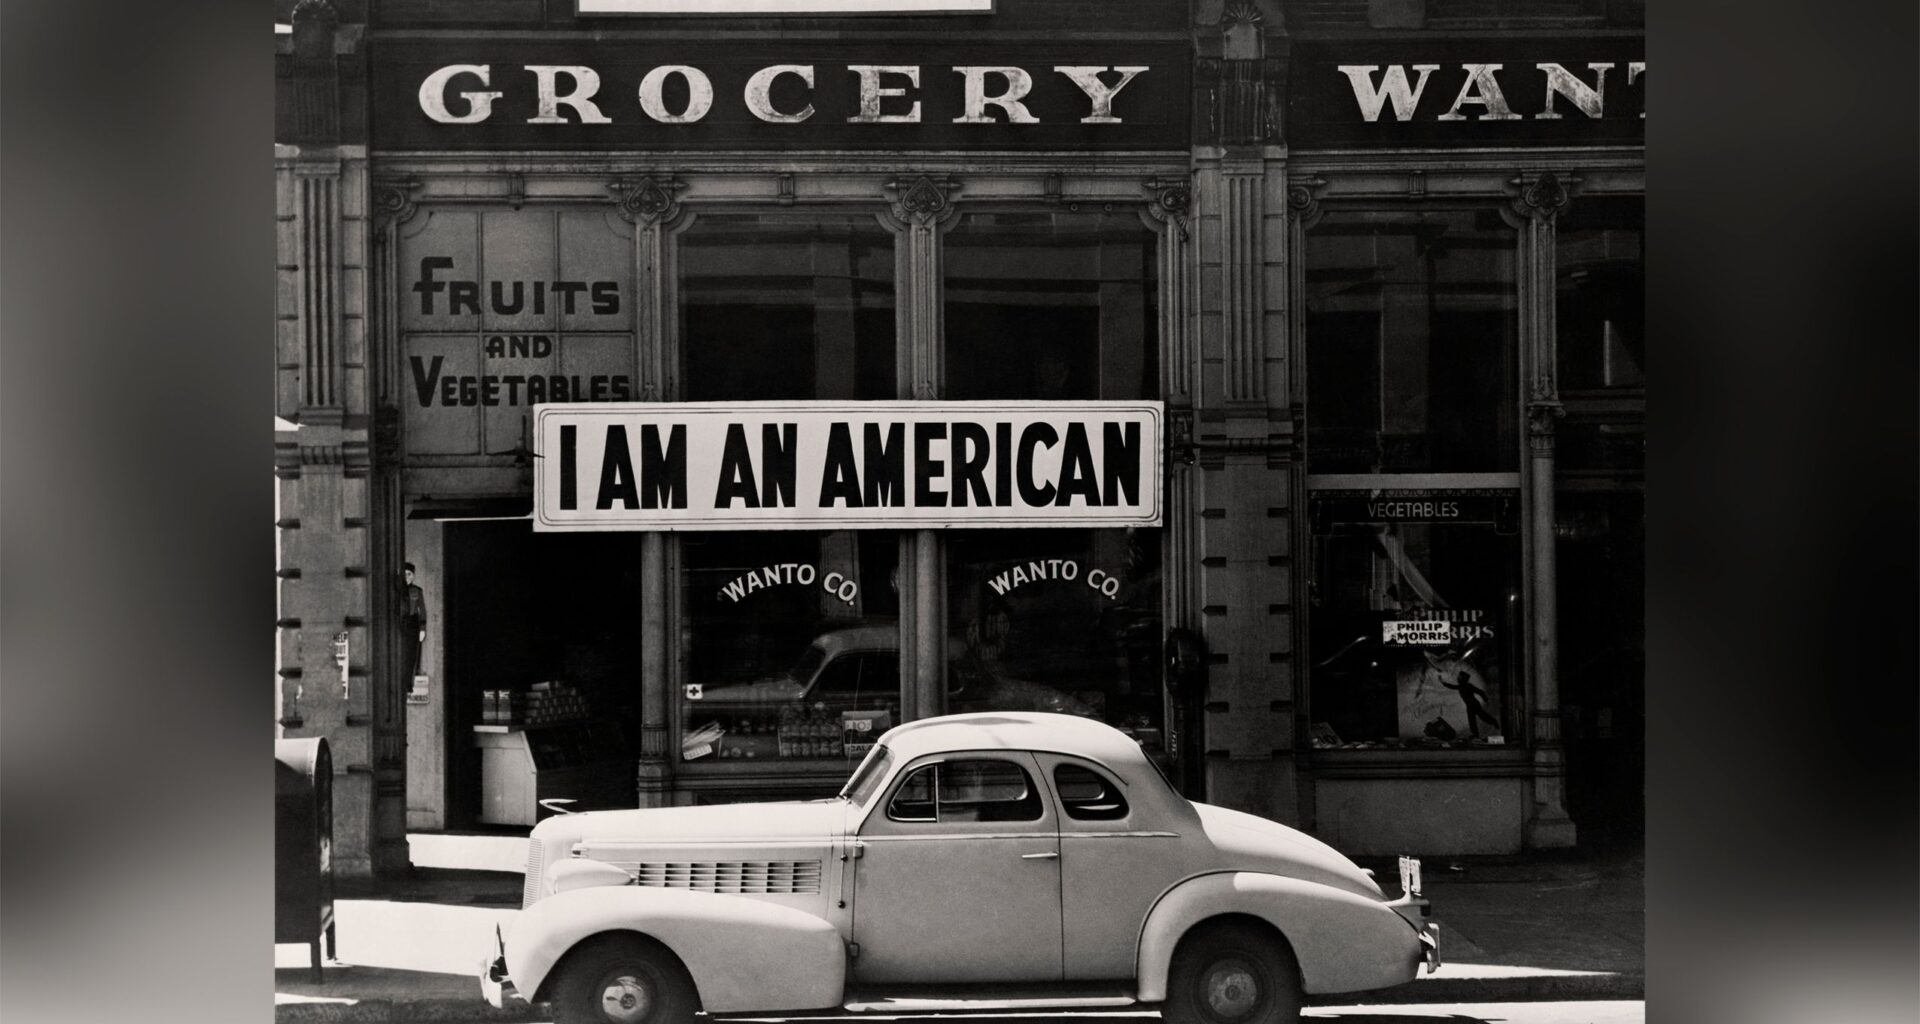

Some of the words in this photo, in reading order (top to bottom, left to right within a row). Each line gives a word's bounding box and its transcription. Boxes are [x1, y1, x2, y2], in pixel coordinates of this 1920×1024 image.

[418, 64, 1150, 124] GROCERY
[412, 256, 621, 316] FRUITS
[485, 335, 552, 359] AND
[409, 355, 630, 408] VEGETABLES
[560, 424, 578, 511] I
[596, 424, 688, 510] AM
[714, 423, 798, 509] AN
[818, 421, 1141, 508] AMERICAN
[1367, 502, 1460, 518] VEGETABLES
[721, 563, 816, 603] WANTO
[823, 572, 858, 606] CO.
[988, 559, 1078, 596] WANTO
[1087, 569, 1119, 600] CO.
[1396, 622, 1443, 632] PHILIP
[1396, 632, 1450, 642] MORRIS
[1450, 625, 1495, 640] RRIS
